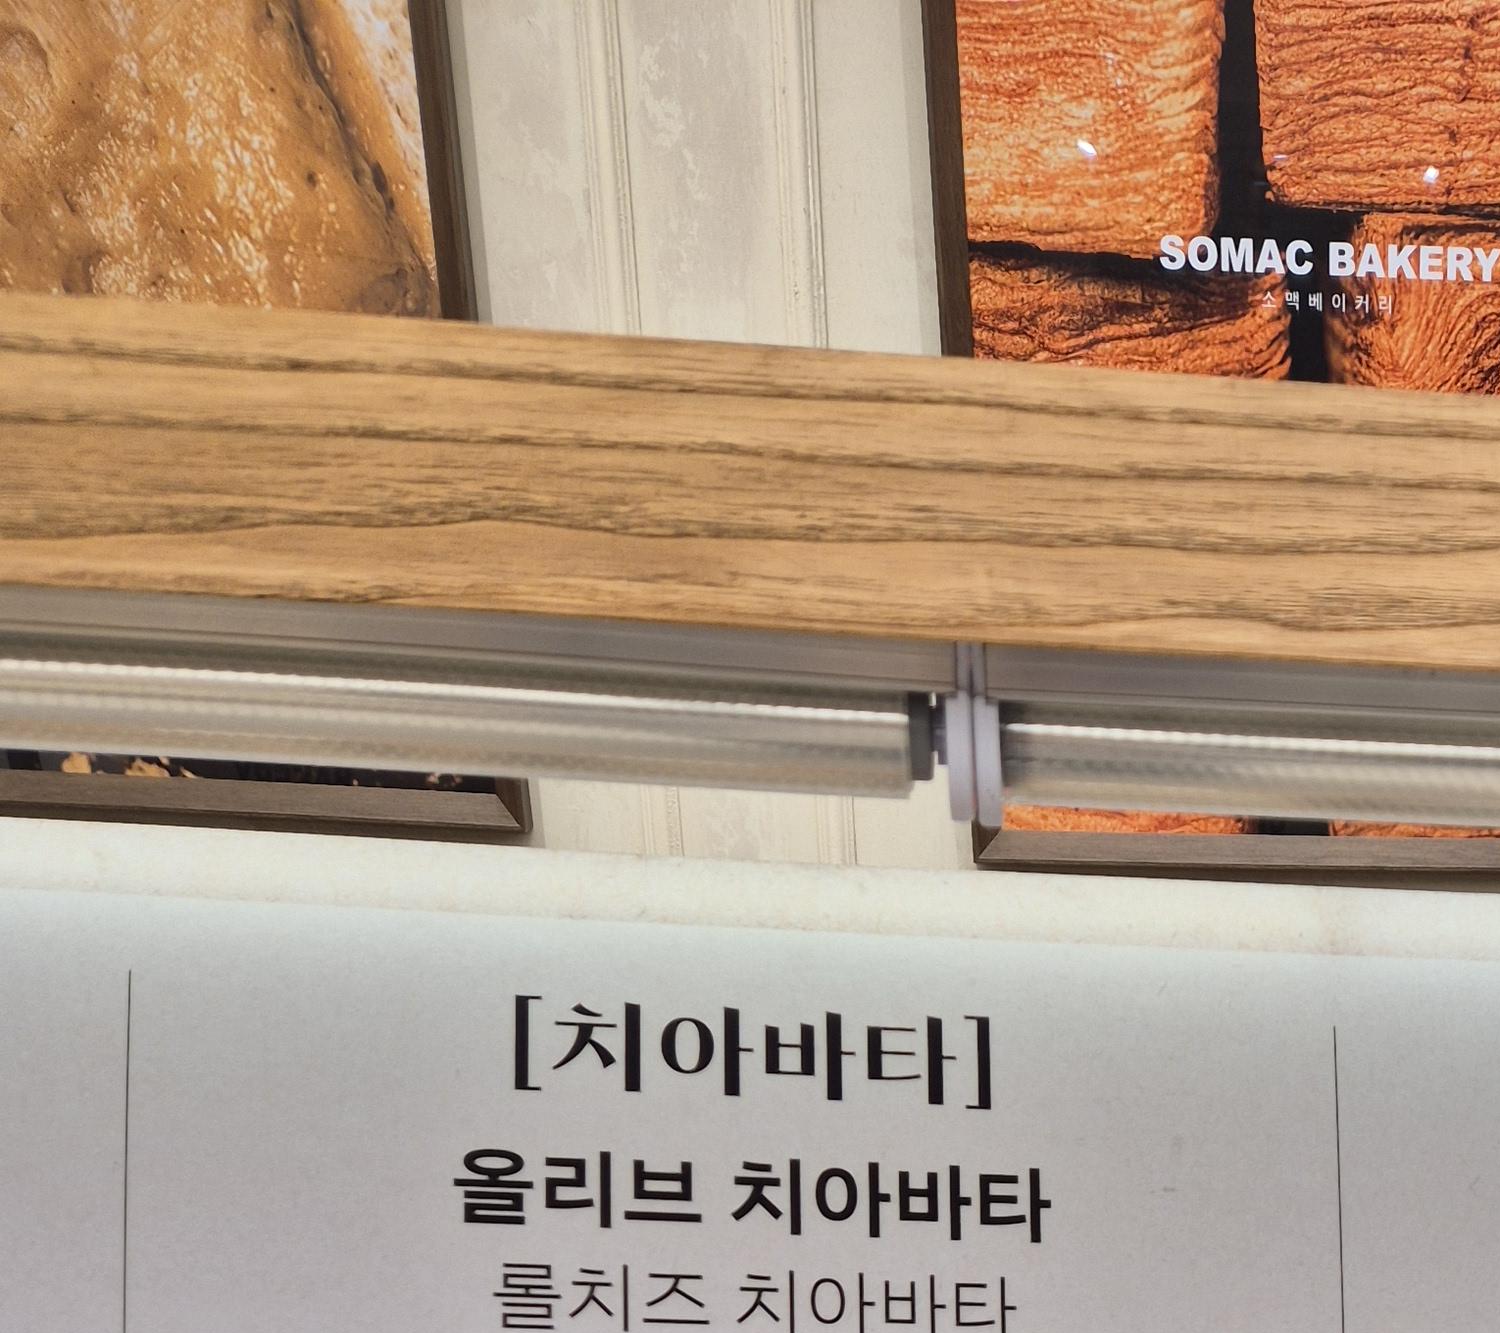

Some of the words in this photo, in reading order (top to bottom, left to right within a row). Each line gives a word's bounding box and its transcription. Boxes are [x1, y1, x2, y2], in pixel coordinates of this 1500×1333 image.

[1160, 235, 1314, 276] SOMAC
[1262, 291, 1393, 314] 소맥베이커리
[515, 994, 992, 1110] [치아바타]
[453, 1149, 702, 1229] 올리브
[731, 1159, 1053, 1243] 치아바타
[493, 1263, 710, 1333] 롤치즈
